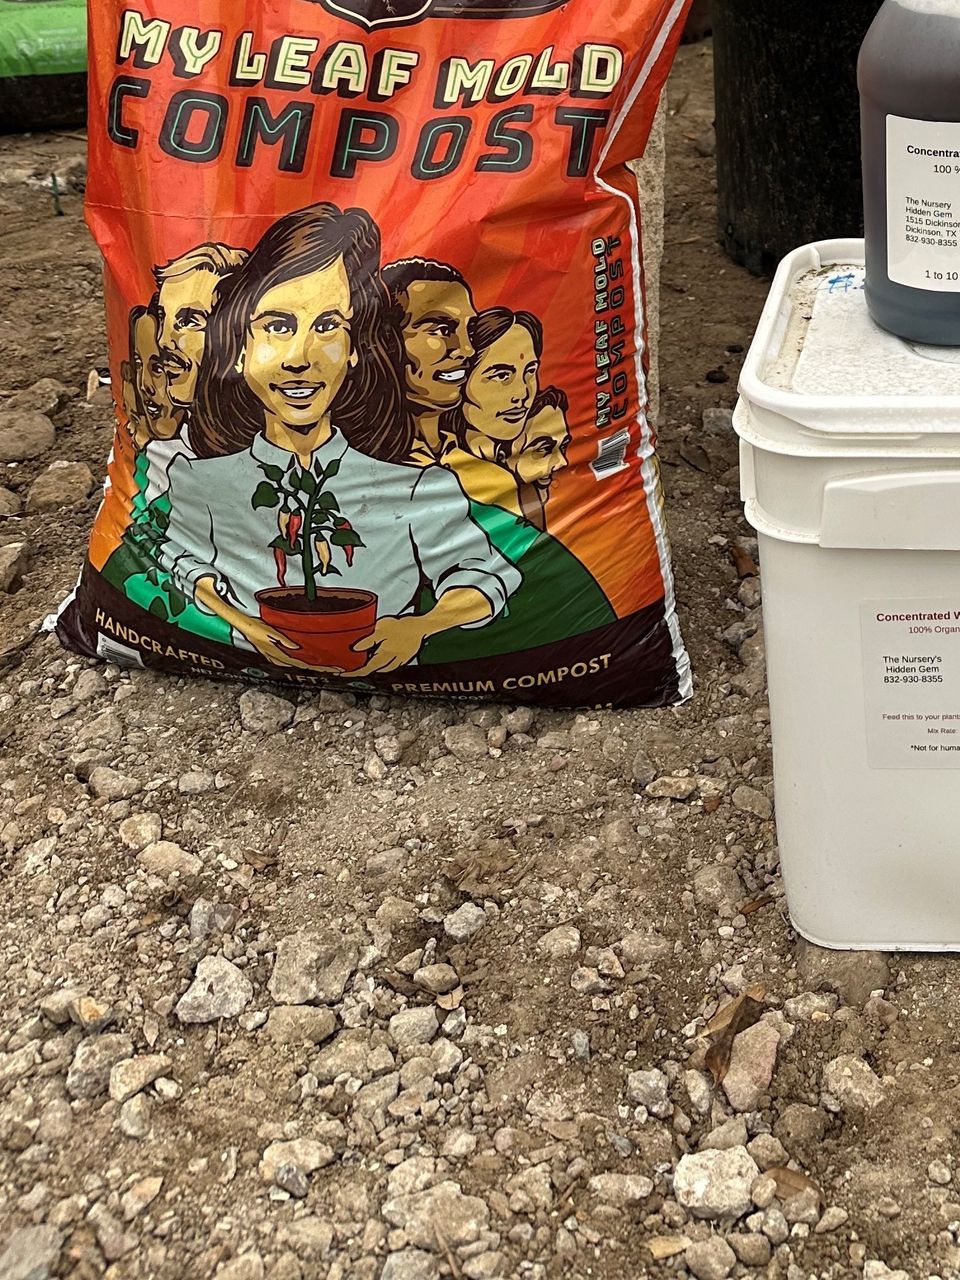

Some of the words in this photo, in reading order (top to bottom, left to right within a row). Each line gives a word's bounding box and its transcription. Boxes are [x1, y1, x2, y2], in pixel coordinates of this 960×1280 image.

[117, 9, 222, 76] MY
[231, 30, 420, 98] LEAF
[437, 43, 623, 106] MOLD
[107, 75, 612, 180] COMPOST
[933, 164, 952, 174] 100
[905, 196, 919, 205] The
[921, 199, 951, 210] Nursery
[905, 206, 931, 216] Hidden
[933, 210, 952, 218] Gem
[905, 216, 923, 225] 1515
[946, 229, 957, 237] TX
[905, 234, 958, 247] 832-930-8355
[592, 237, 608, 313] MOLD
[925, 270, 931, 279] 1
[934, 271, 943, 280] to
[946, 272, 958, 281] 10
[606, 235, 628, 419] COMPOST
[595, 320, 611, 384] LEAF
[595, 391, 612, 428] MY
[876, 611, 951, 622] Concentrated
[908, 625, 932, 634] 100%
[95, 608, 225, 670] HANDCRAFTED
[391, 680, 495, 693] PREMIUM
[502, 653, 612, 690] COMPOST
[882, 655, 899, 664] The
[901, 655, 942, 665] Nursery's
[885, 665, 916, 674] Hidden
[918, 665, 940, 673] Gem
[883, 675, 943, 684] 832-930-8355
[924, 714, 940, 722] your
